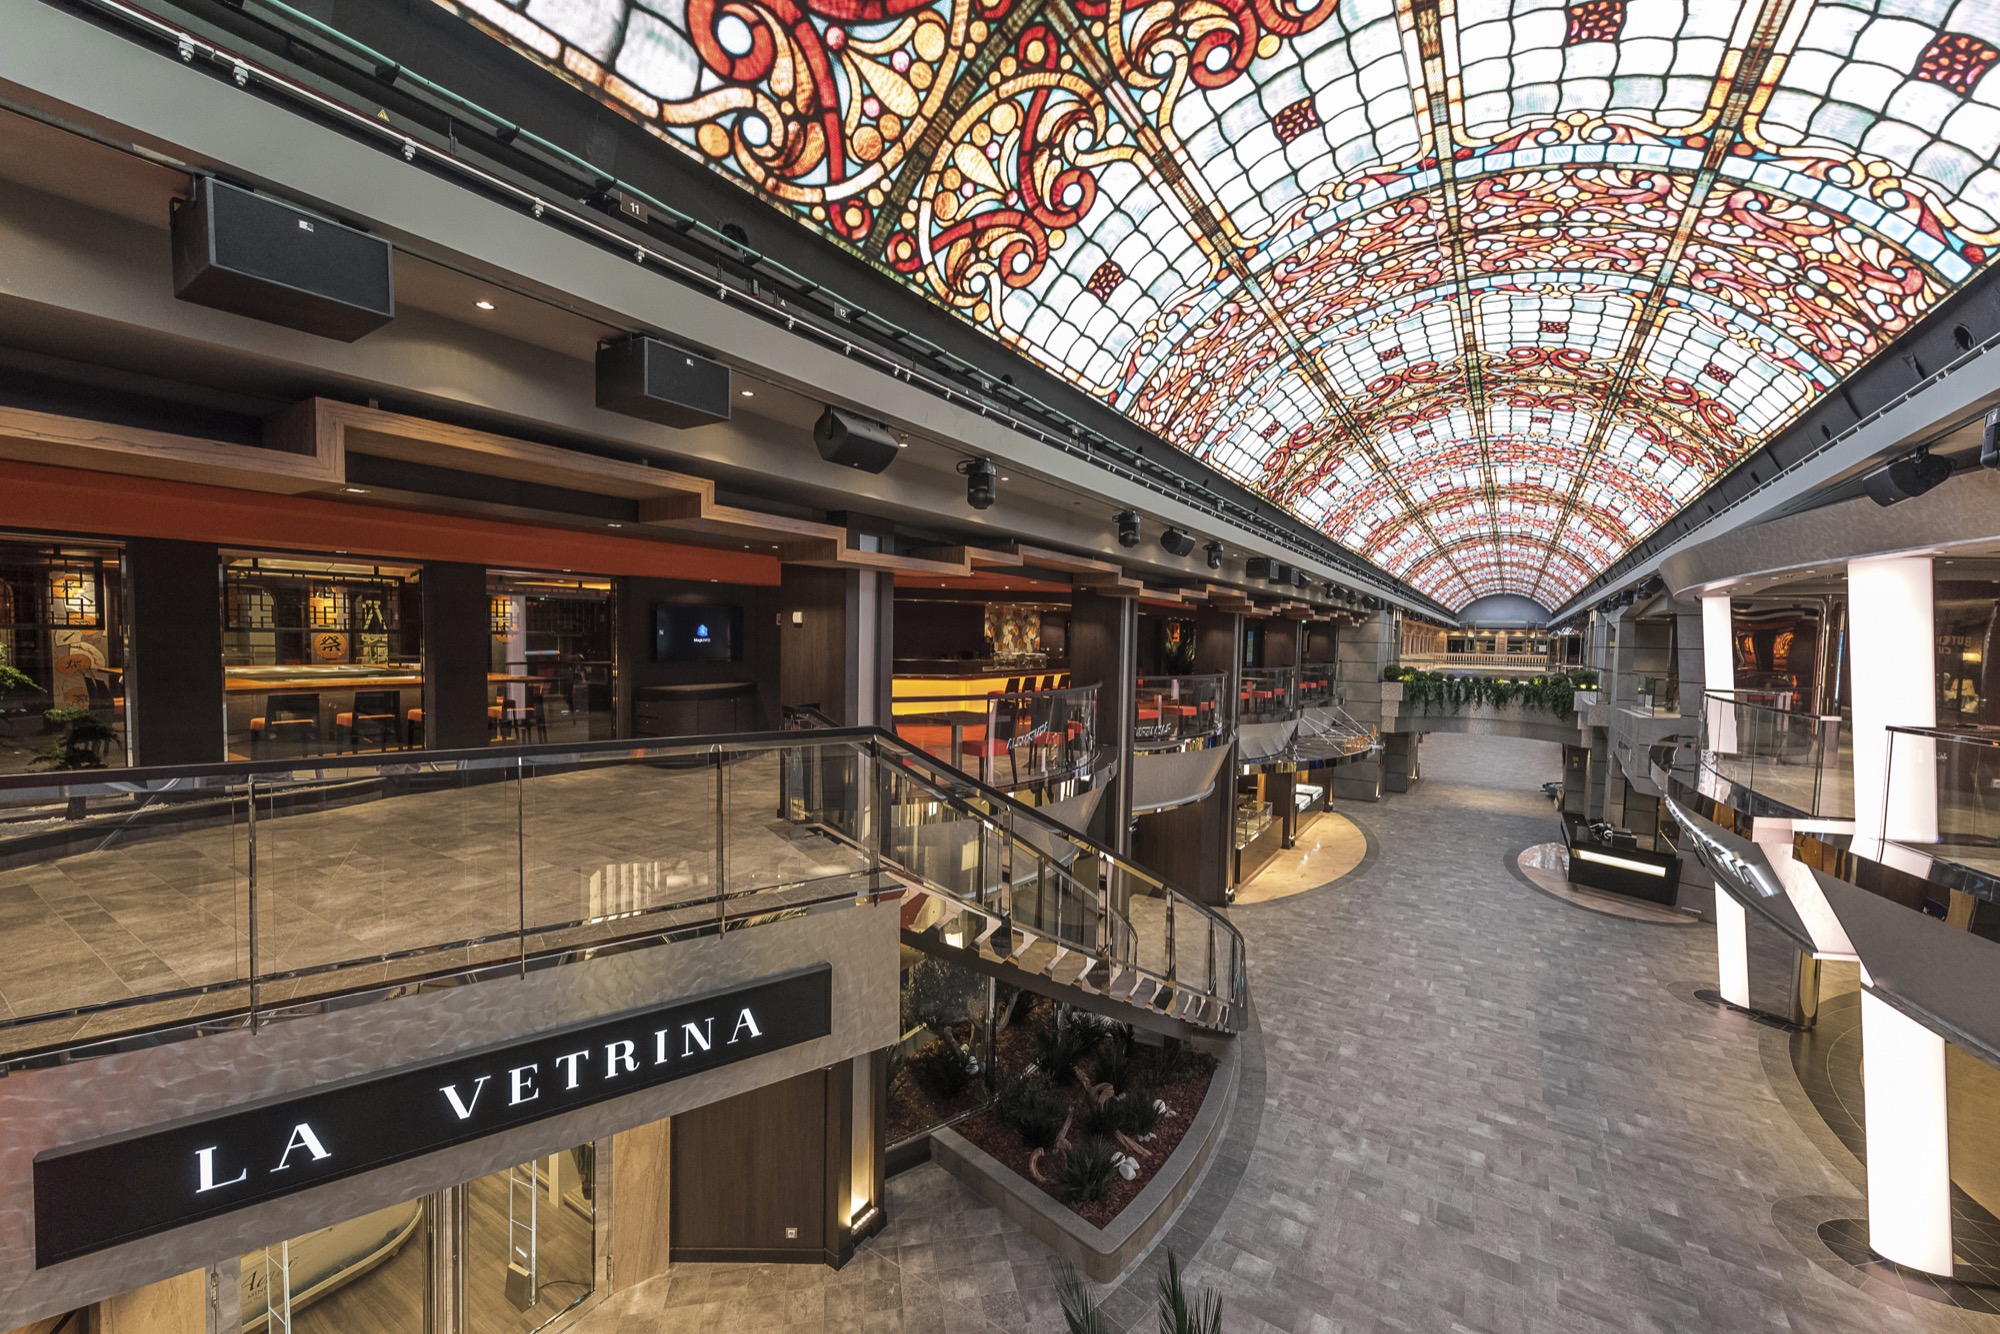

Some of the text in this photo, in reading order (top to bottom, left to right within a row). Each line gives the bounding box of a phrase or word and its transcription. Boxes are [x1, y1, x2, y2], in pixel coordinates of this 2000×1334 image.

[629, 202, 640, 215] 11
[839, 308, 847, 318] 12
[194, 1007, 763, 1194] LA VETRINA
